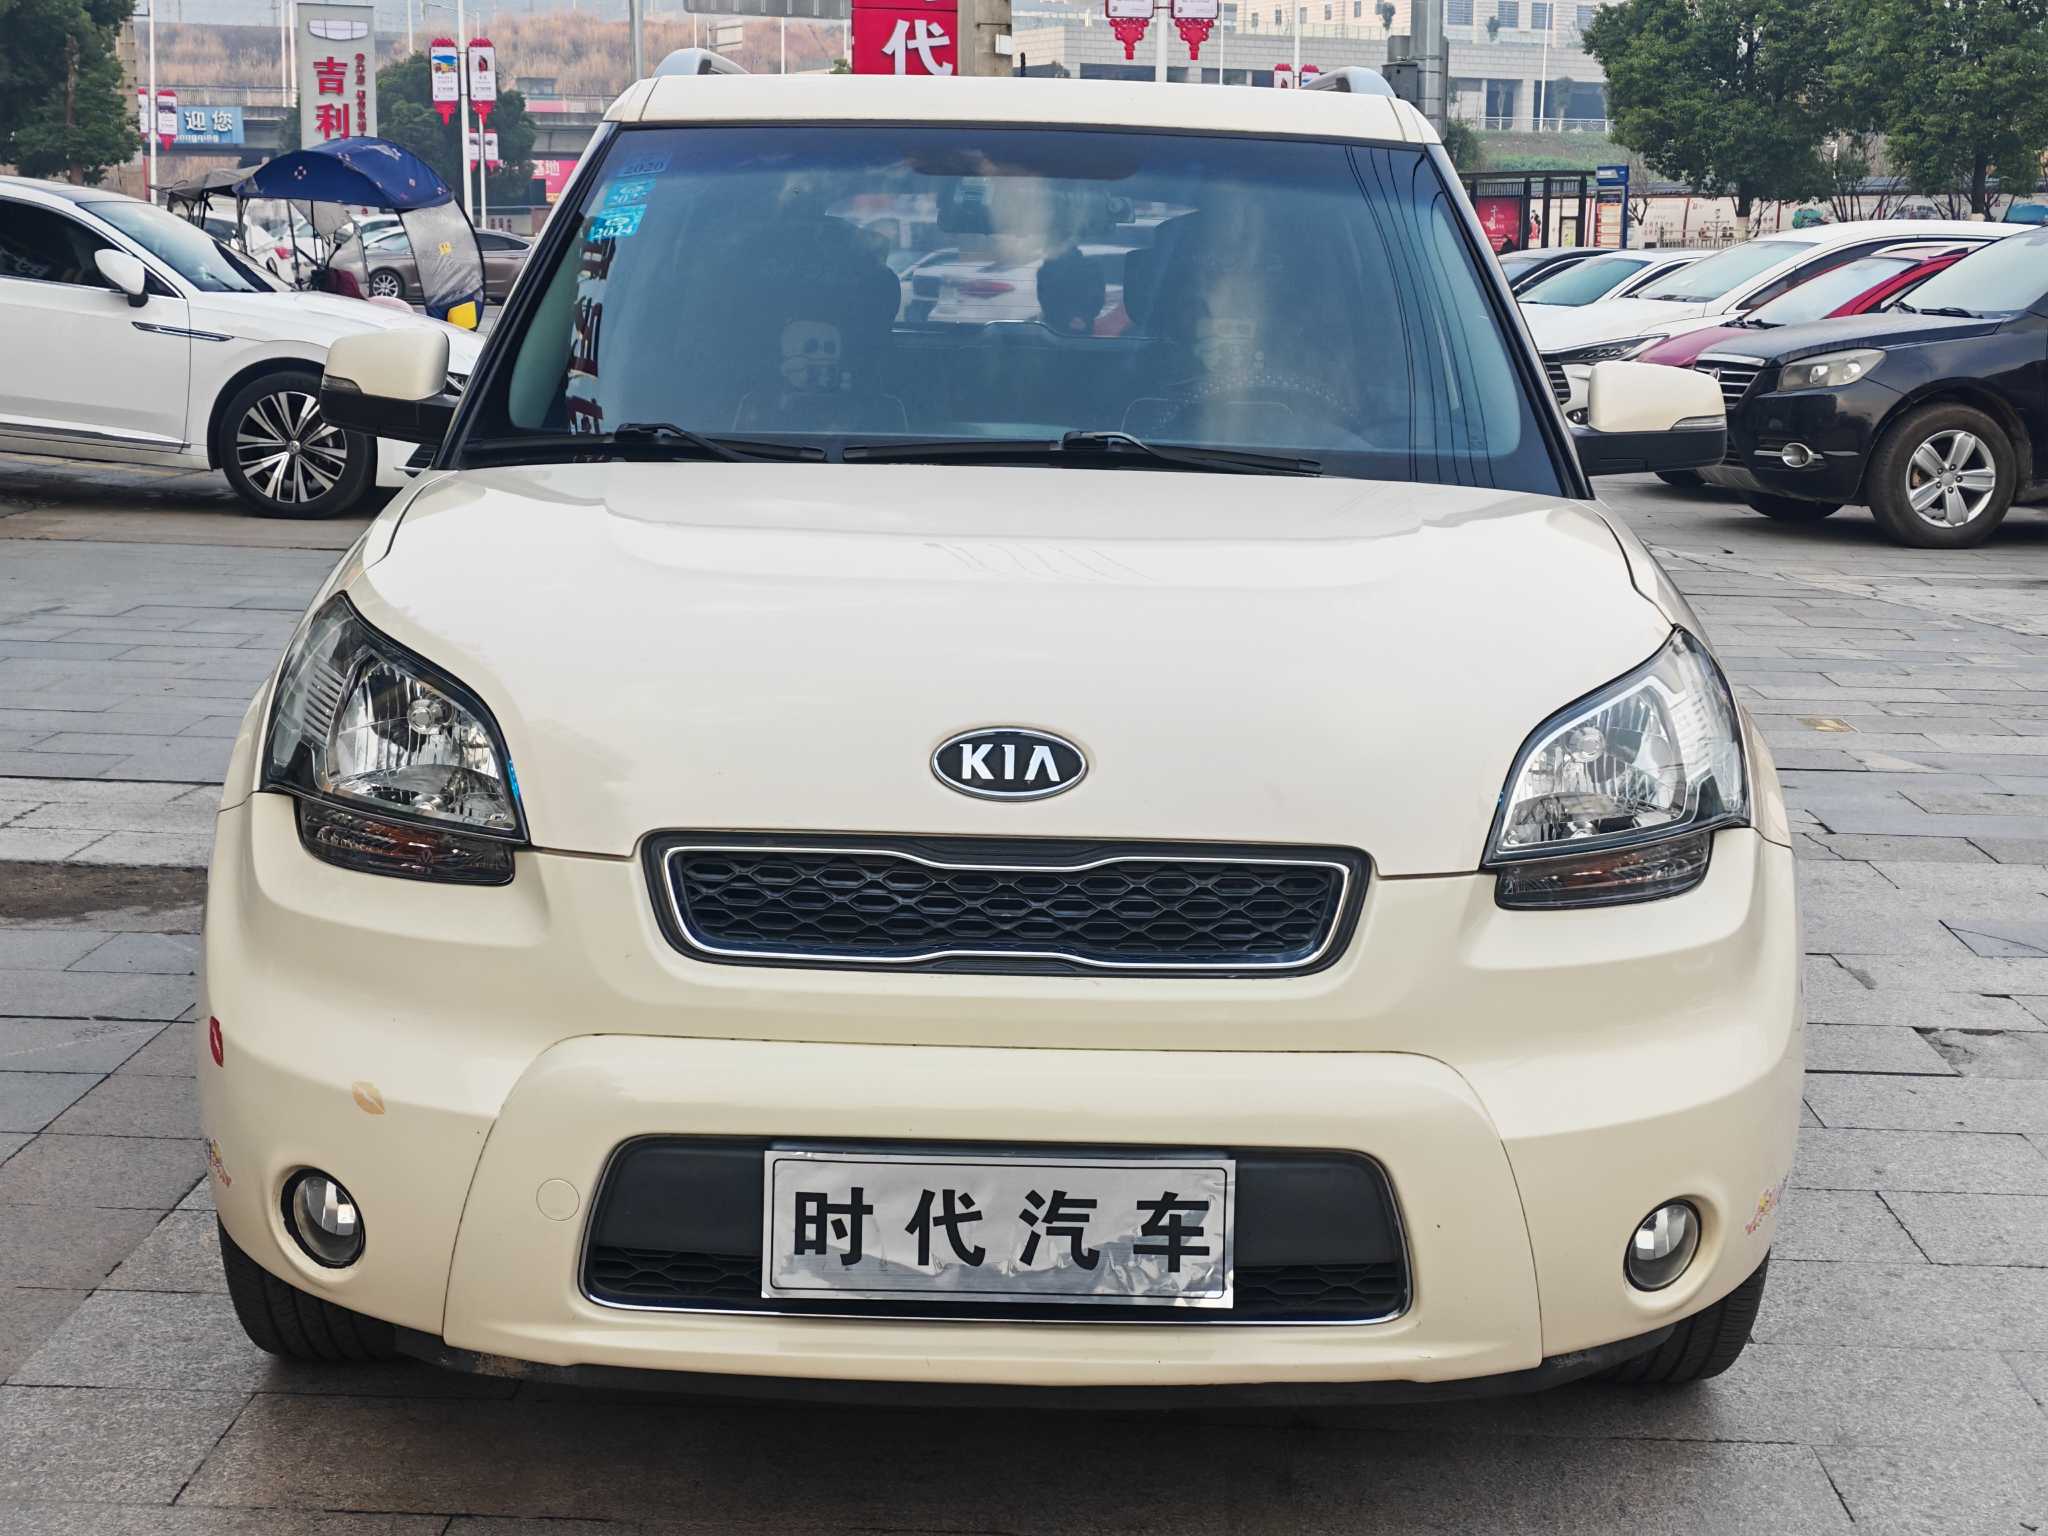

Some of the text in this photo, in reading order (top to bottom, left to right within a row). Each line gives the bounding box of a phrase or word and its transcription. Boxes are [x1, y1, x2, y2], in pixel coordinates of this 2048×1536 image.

[882, 0, 953, 75] 代
[184, 110, 232, 132] 迎您
[313, 56, 350, 141] 吉利
[959, 743, 1061, 782] KIA
[794, 1187, 1211, 1273] 时代汽车
